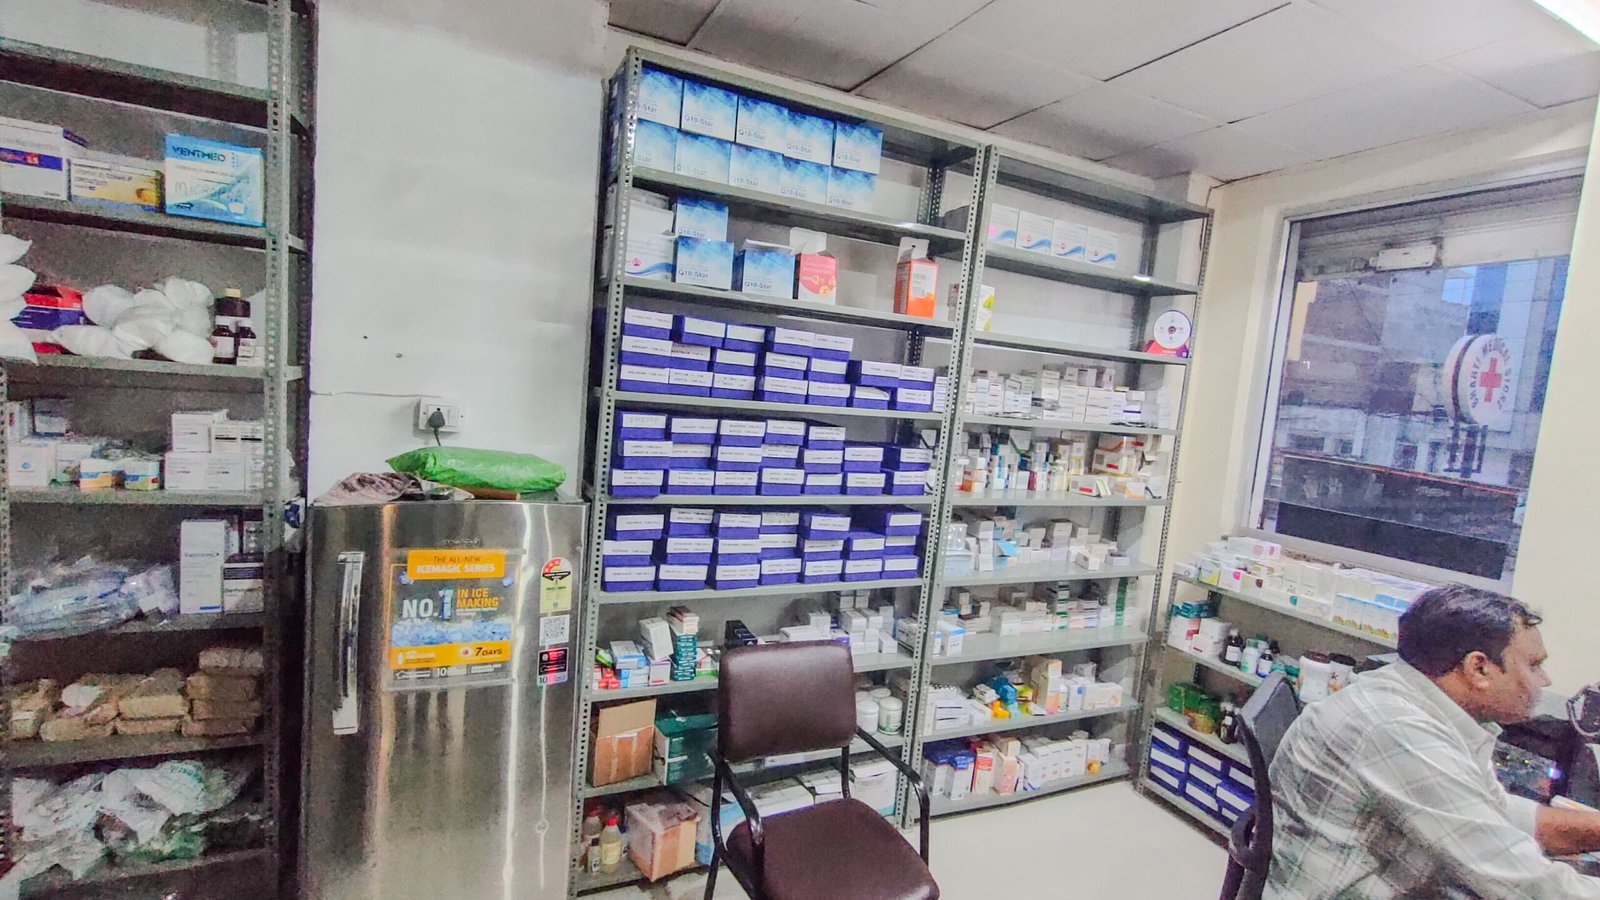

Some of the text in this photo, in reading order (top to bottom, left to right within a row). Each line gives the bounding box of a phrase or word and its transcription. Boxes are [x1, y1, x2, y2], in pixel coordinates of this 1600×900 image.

[738, 129, 766, 140] Q10-Star
[786, 143, 813, 153] Q10-Star
[171, 145, 226, 162] VENTMED
[678, 269, 708, 279] Q10-Star
[744, 280, 772, 290] Q10-Star
[457, 587, 490, 598] IN ICE
